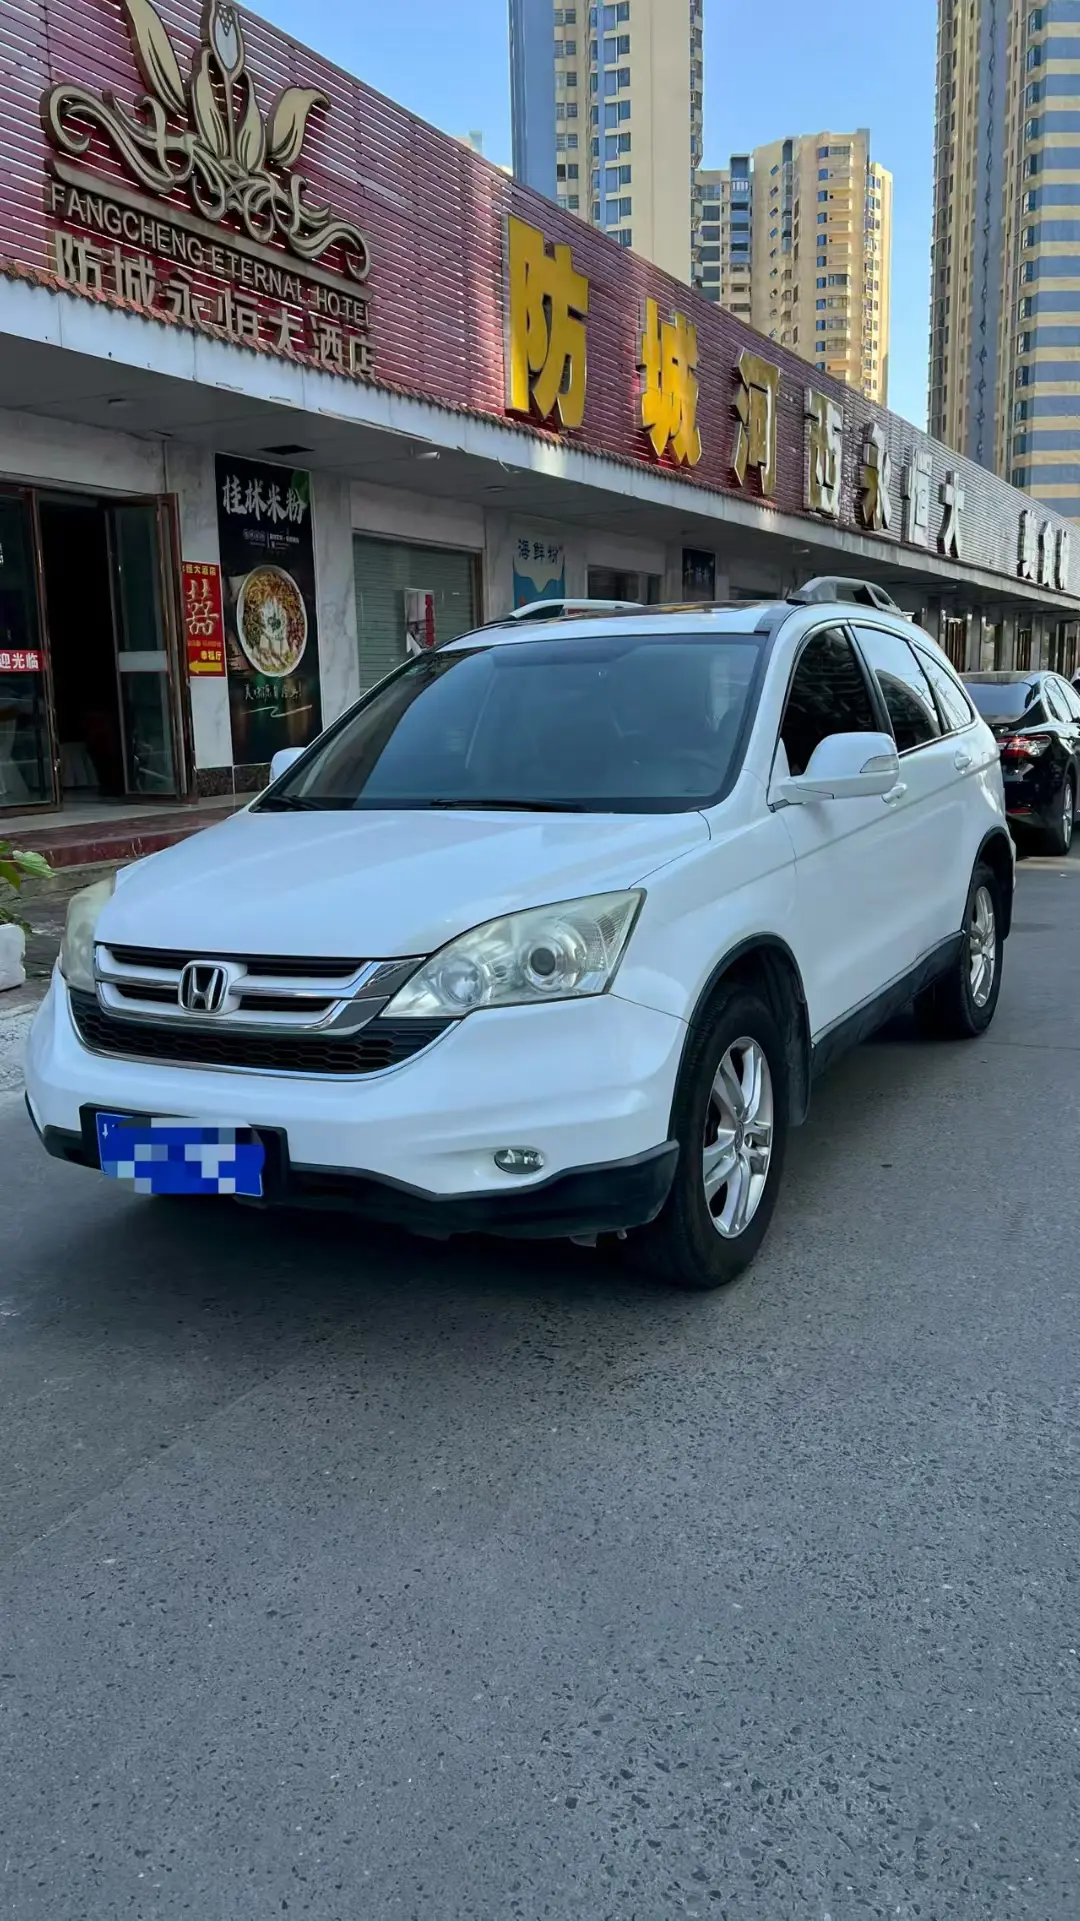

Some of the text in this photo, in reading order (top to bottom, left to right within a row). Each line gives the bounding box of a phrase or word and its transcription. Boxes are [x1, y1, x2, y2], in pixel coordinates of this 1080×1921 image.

[50, 182, 373, 329] FANGCHENG ETERNAL HOTEL
[53, 229, 377, 381] 防城永恒大酒店
[221, 474, 308, 525] 桂林米粉
[182, 564, 217, 577] 恒大酒店
[0, 651, 39, 670] 迎光临
